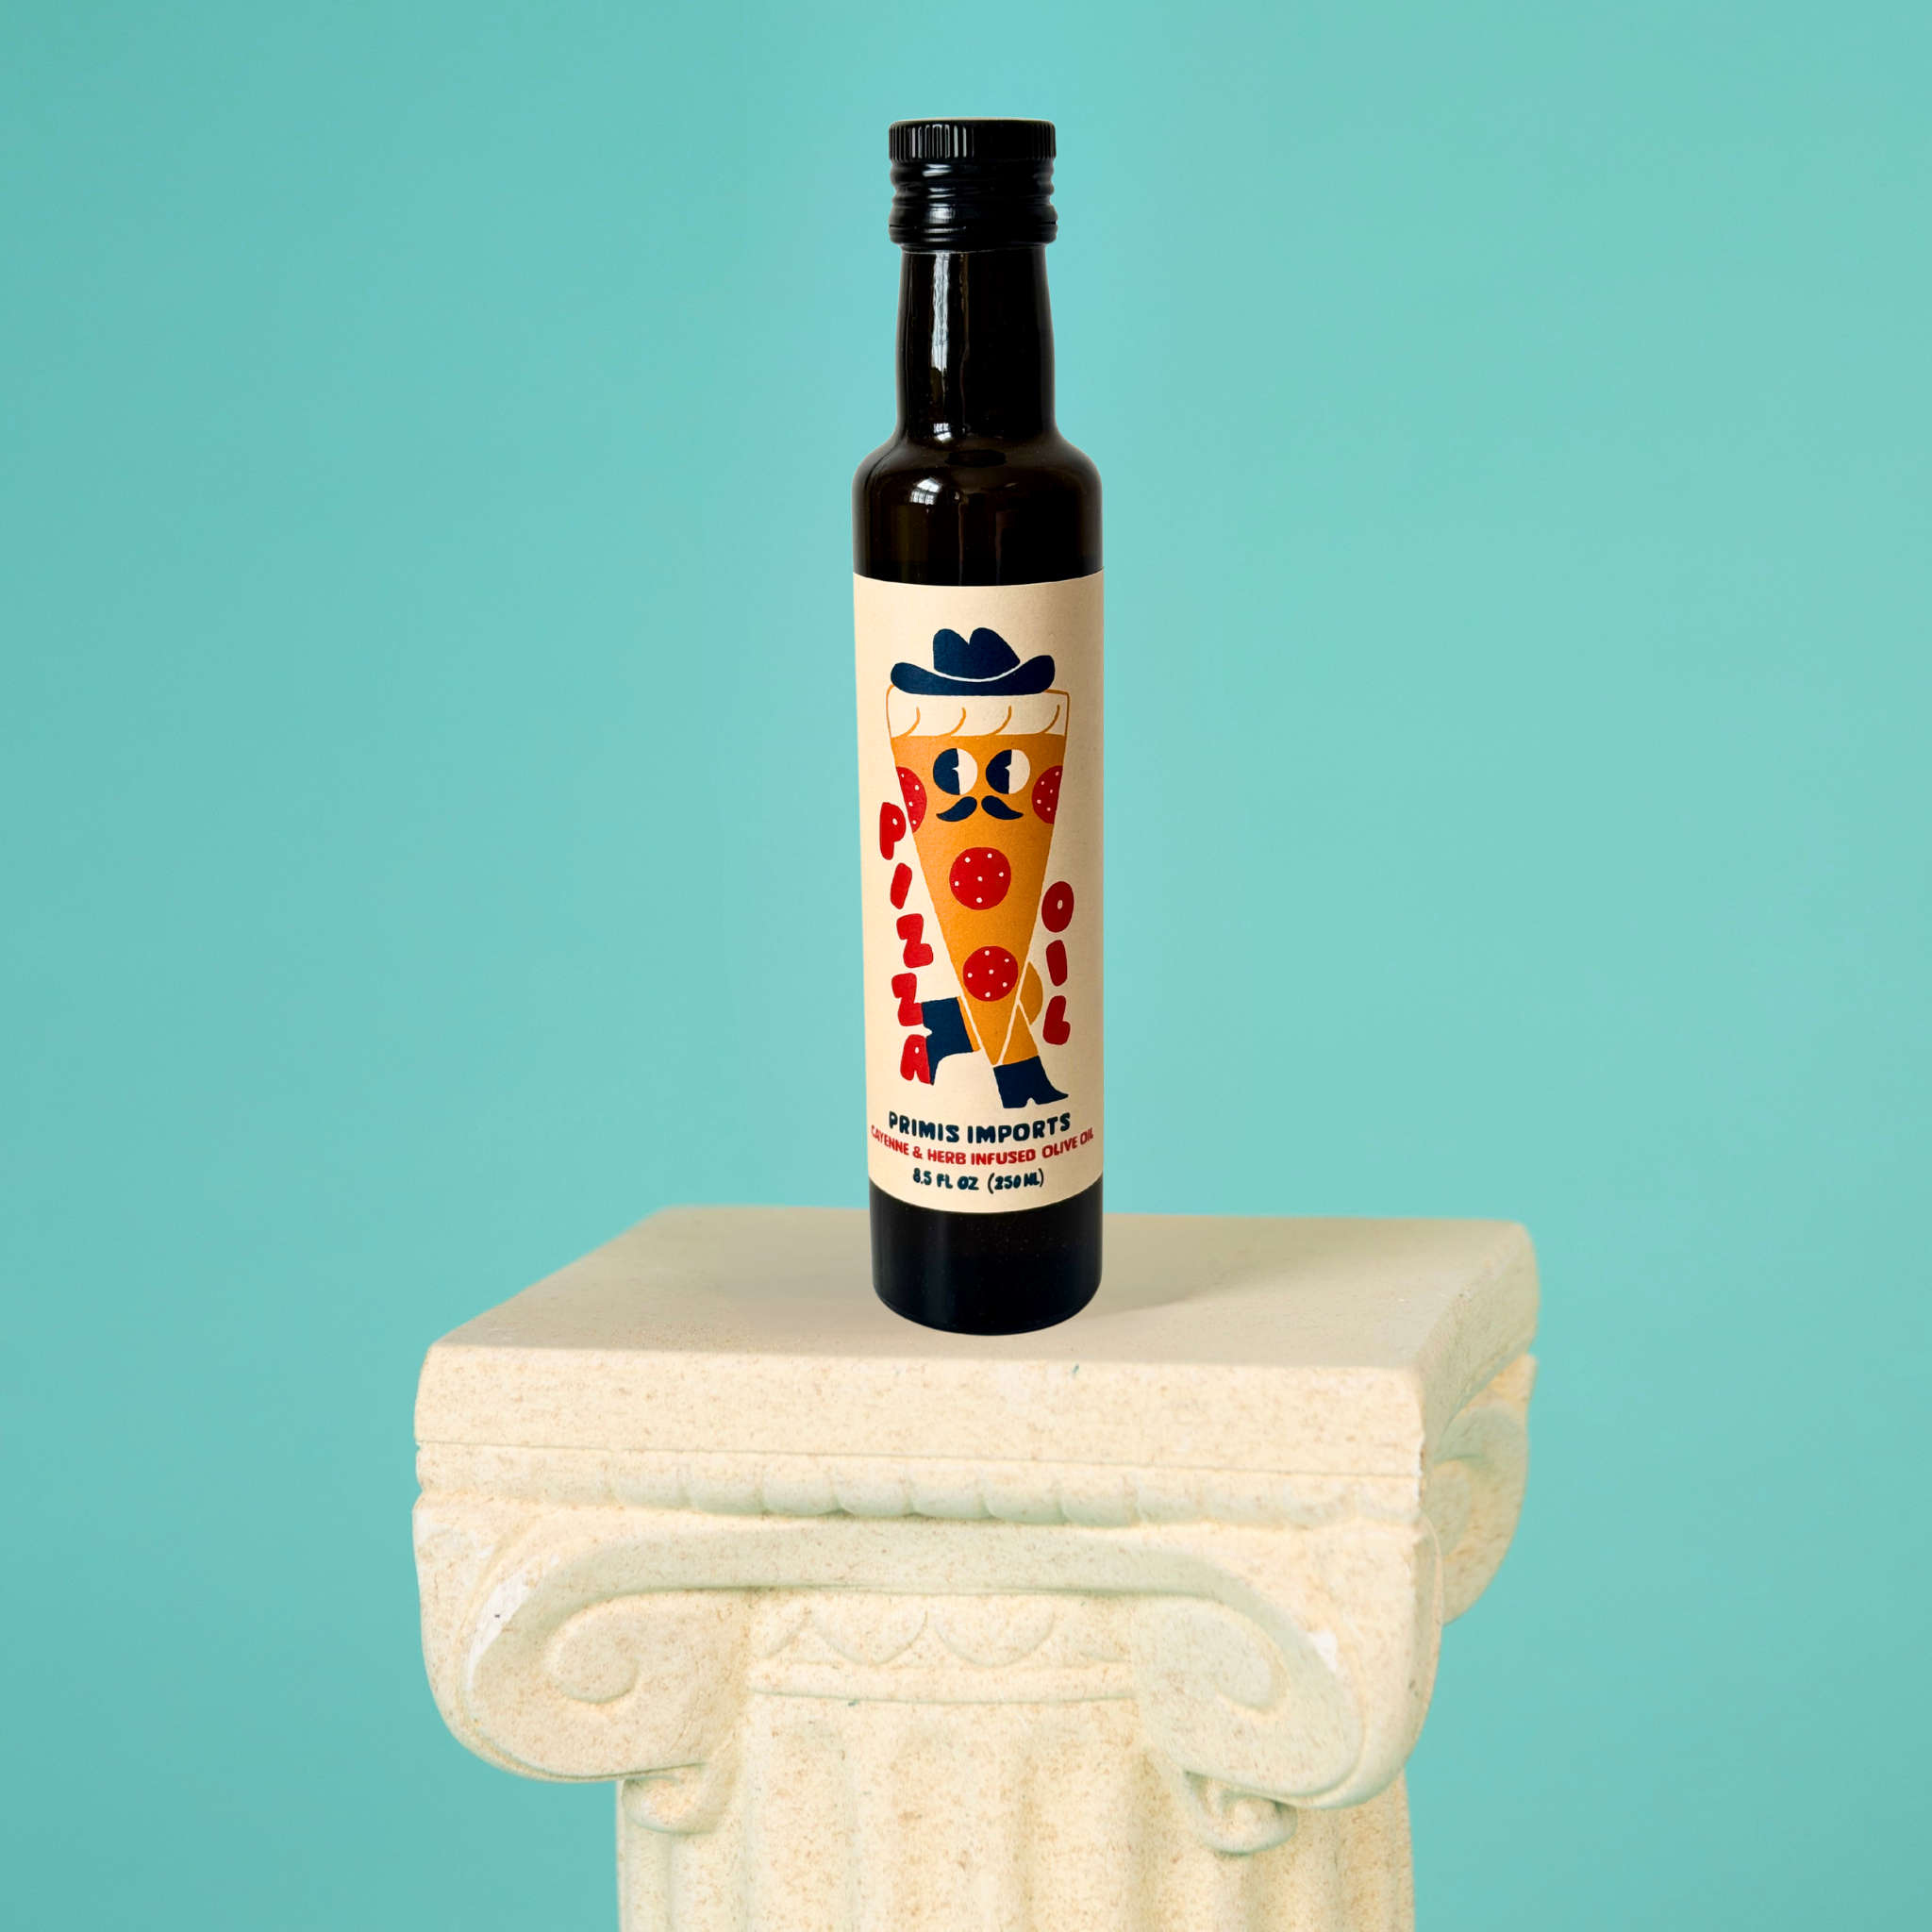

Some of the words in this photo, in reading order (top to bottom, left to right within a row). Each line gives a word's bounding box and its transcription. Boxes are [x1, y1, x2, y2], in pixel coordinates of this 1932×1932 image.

[879, 802, 934, 1085] PIZZA
[1041, 880, 1074, 1045] OIL
[871, 1124, 909, 1156] CAYENNE
[912, 1145, 923, 1159] &
[928, 1148, 967, 1165] HERB
[971, 1148, 1036, 1165] INFUSED
[1041, 1139, 1077, 1158] OLIVE
[1080, 1127, 1094, 1145] OIL
[889, 1111, 959, 1142] PRIMIS
[967, 1112, 1071, 1143] IMPORTS
[912, 1168, 932, 1185] 8.5
[937, 1173, 953, 1189] FL
[958, 1175, 979, 1191] OZ
